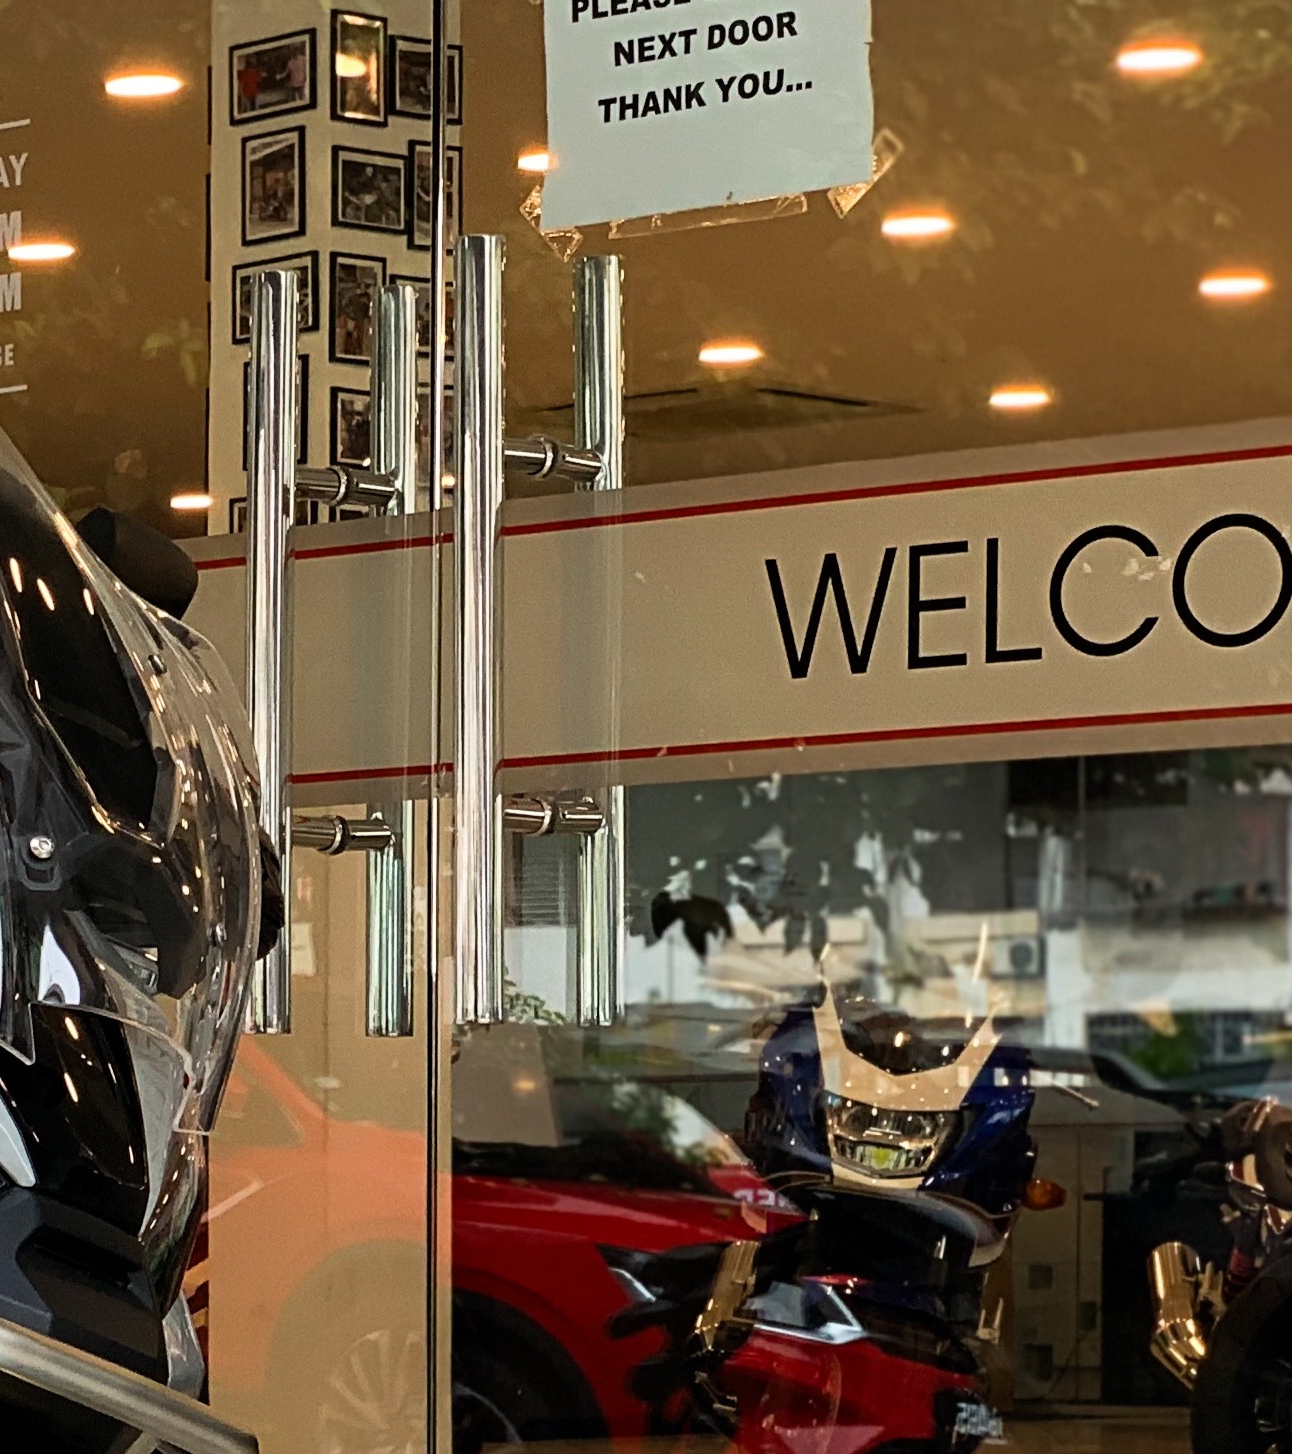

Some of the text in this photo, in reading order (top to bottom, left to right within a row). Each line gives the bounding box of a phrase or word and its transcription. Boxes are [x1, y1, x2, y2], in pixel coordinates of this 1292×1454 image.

[572, 0, 691, 23] PLEA
[613, 11, 798, 67] NEXT DOOR
[598, 69, 813, 123] THANK YOU...
[765, 513, 1292, 679] WELCO
